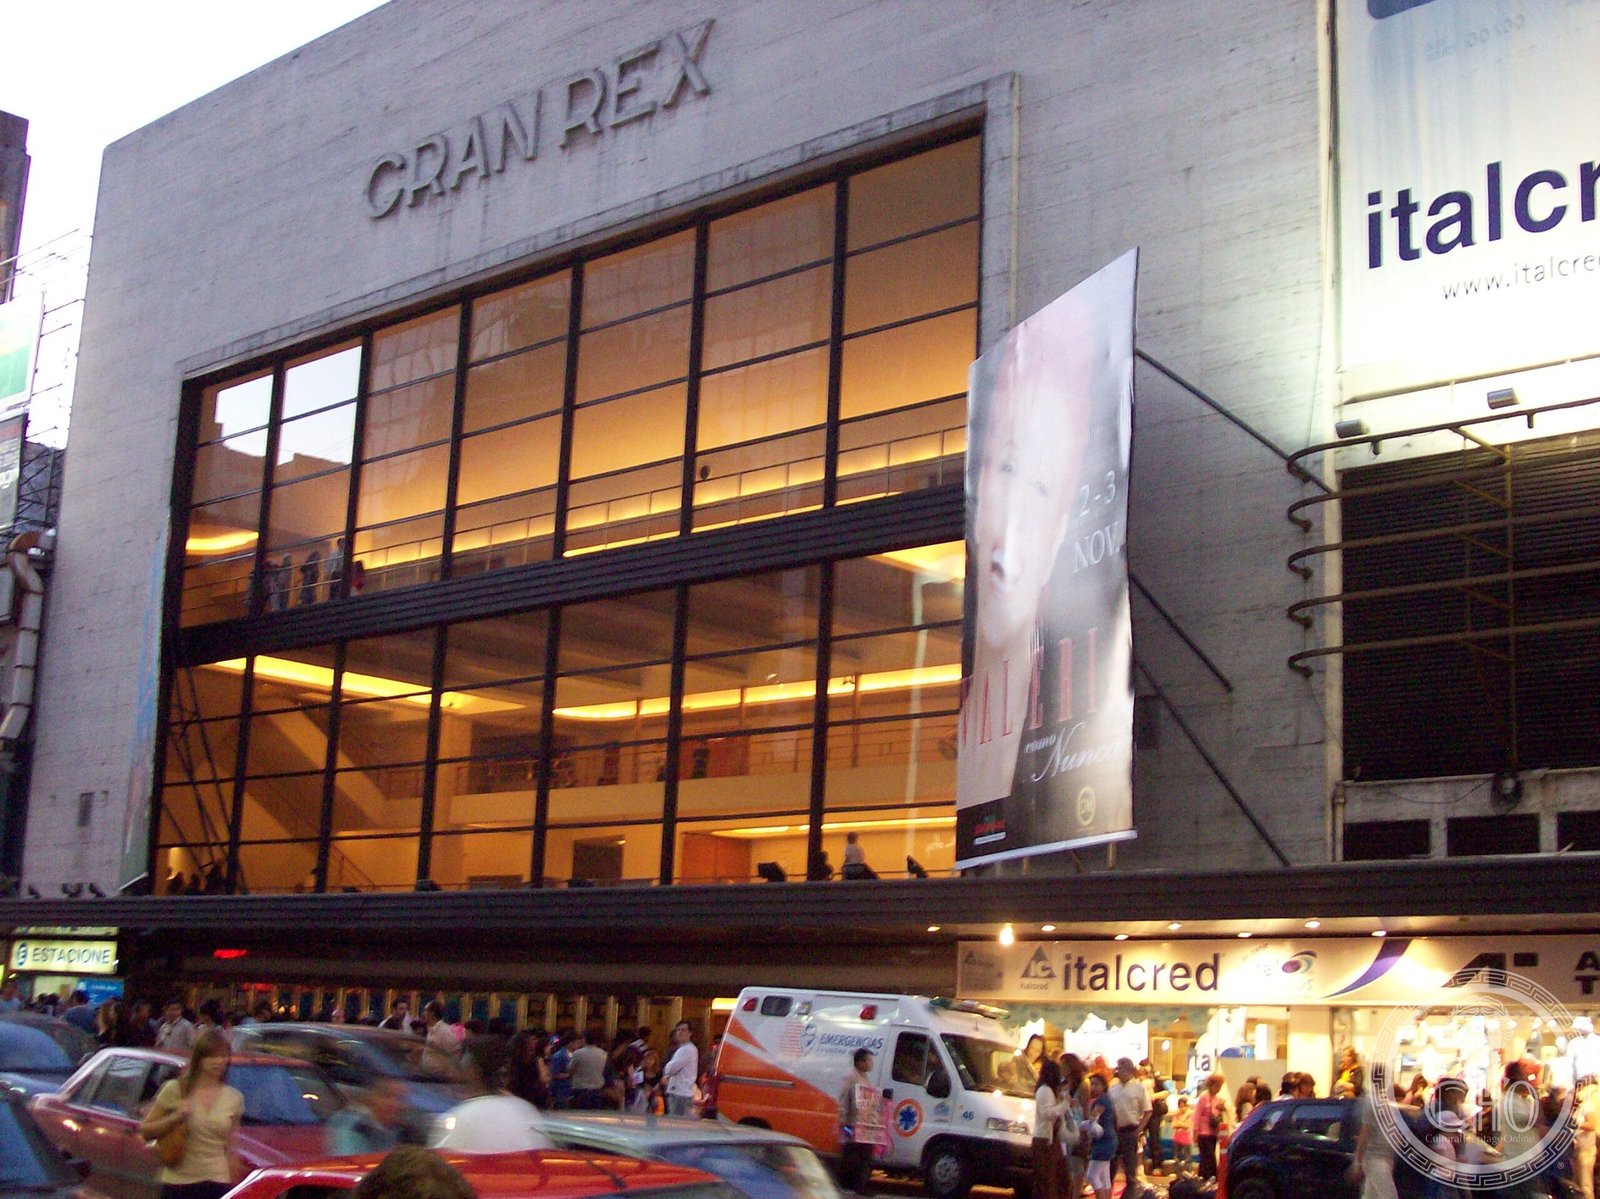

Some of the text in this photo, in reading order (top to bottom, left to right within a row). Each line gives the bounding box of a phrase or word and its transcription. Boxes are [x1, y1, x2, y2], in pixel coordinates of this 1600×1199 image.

[557, 18, 716, 149] REX
[32, 948, 111, 964] ESTACIONE
[1063, 952, 1221, 992] italcred
